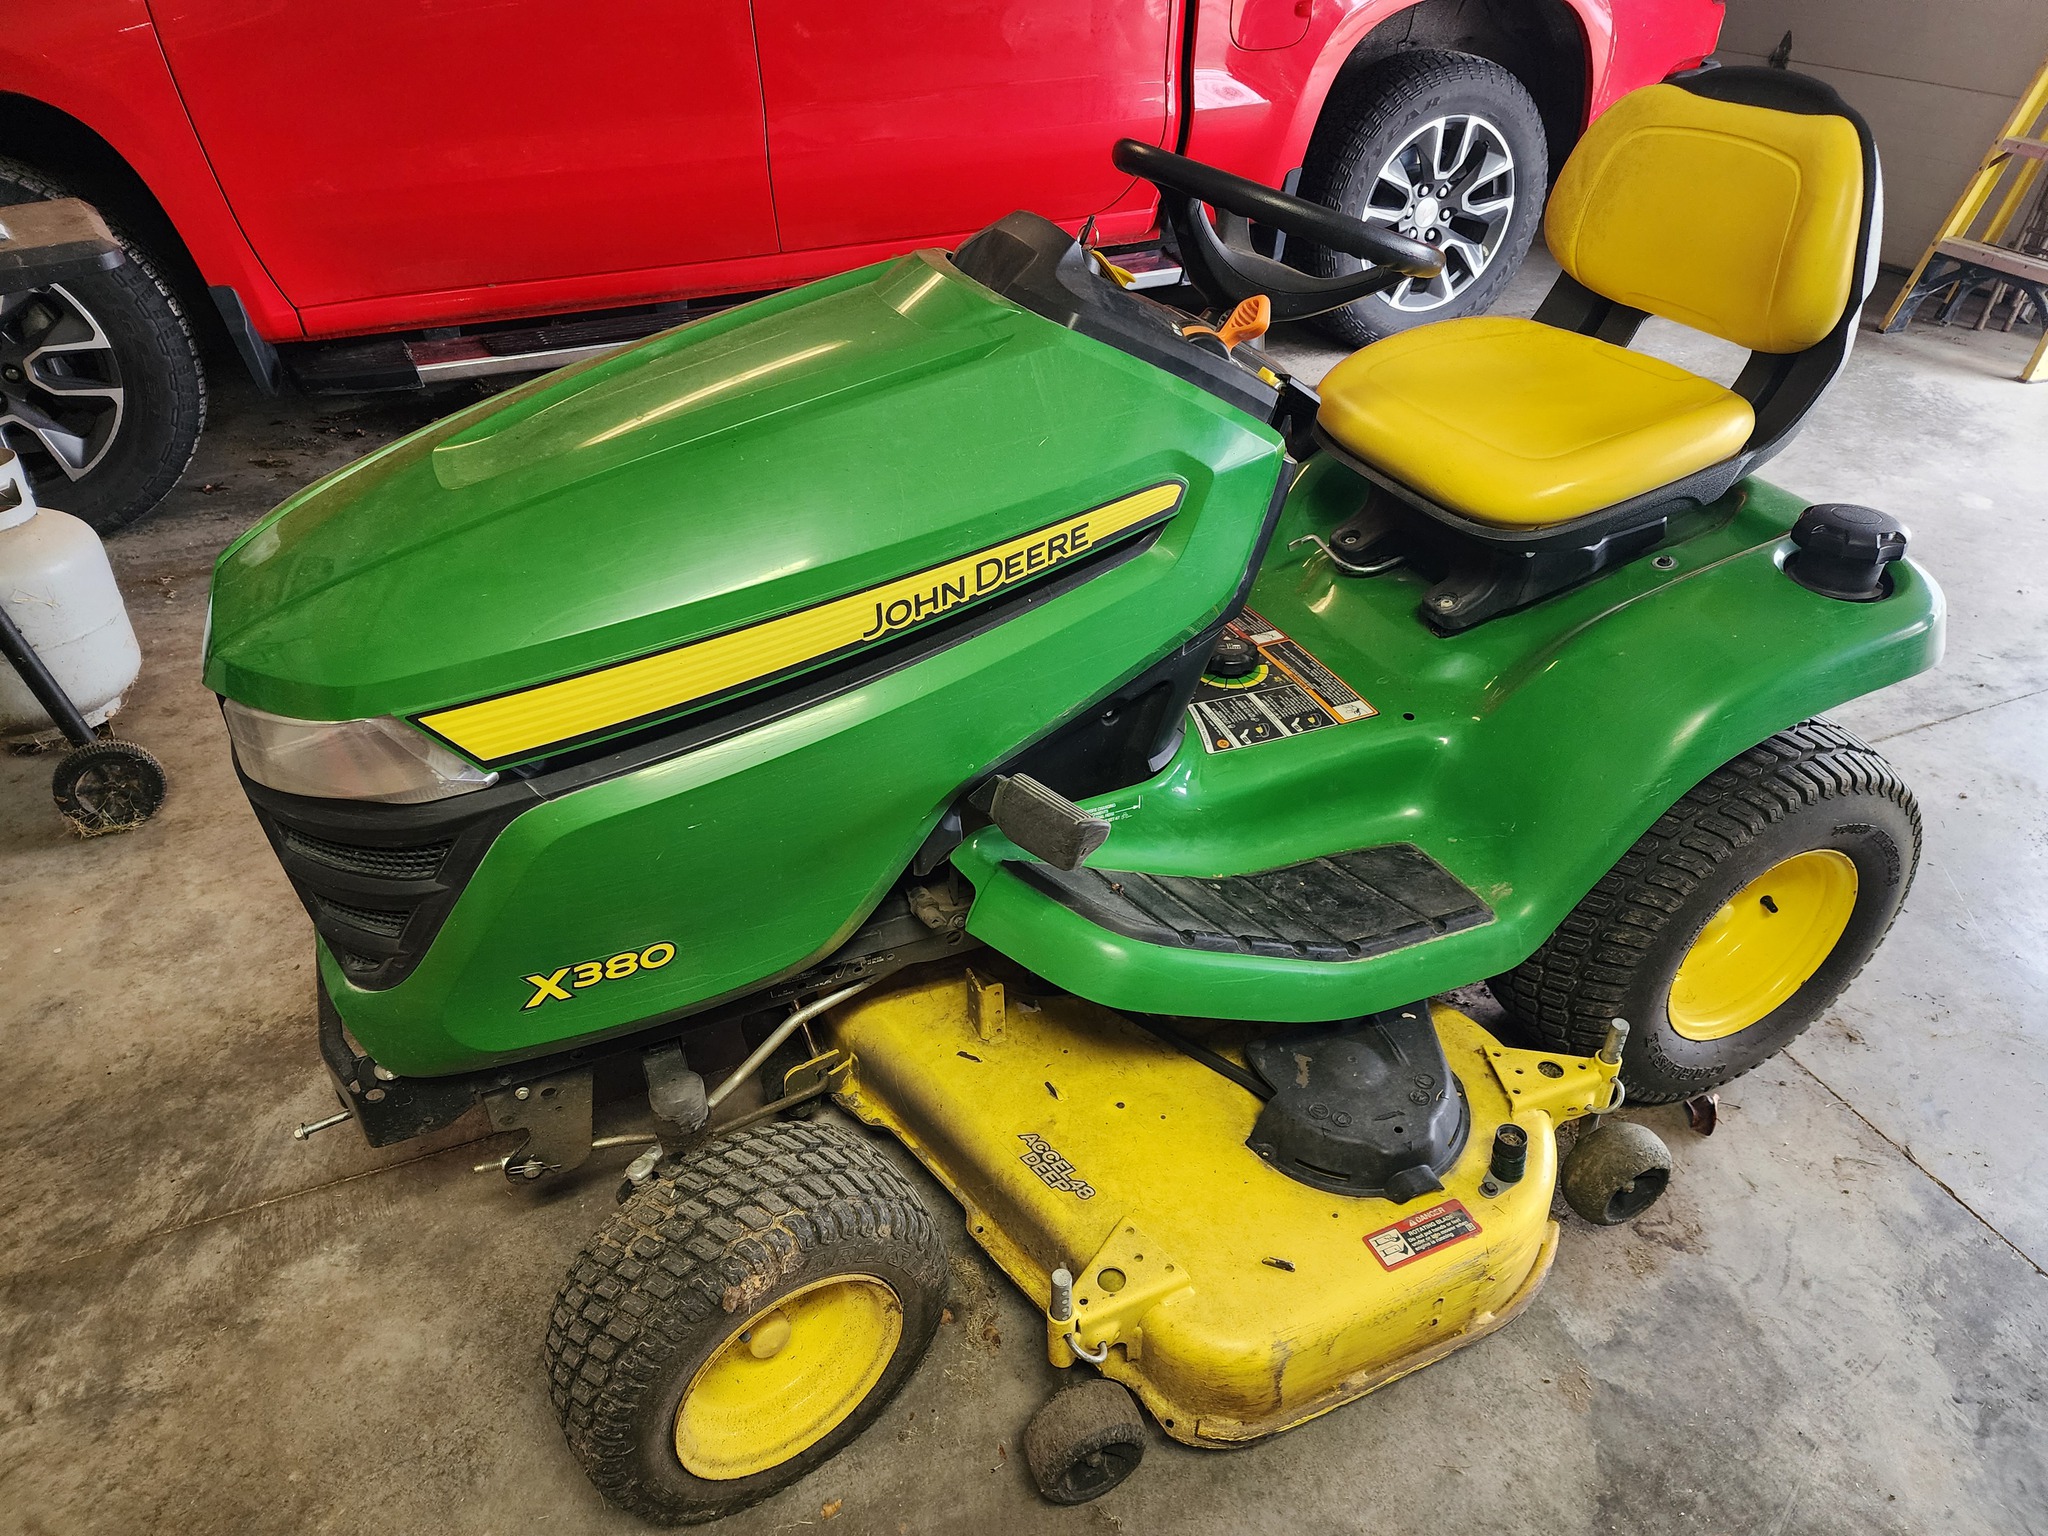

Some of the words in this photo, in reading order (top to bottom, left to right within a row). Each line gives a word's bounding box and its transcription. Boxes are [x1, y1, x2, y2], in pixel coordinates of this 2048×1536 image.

[862, 575, 966, 639] JOHN
[975, 521, 1090, 593] DEERE
[519, 941, 677, 1011] X380
[1645, 1033, 1727, 1081] CARLISLE
[1017, 1132, 1076, 1182] ACCEL
[1069, 1179, 1096, 1200] 48
[1019, 1151, 1071, 1192] DEEP
[1407, 1221, 1436, 1236] ROTATING
[1415, 1207, 1446, 1222] DANGER
[1431, 1224, 1446, 1233] hands
[1411, 1238, 1425, 1247] under
[1440, 1226, 1456, 1235] mower
[1414, 1242, 1431, 1251] engine
[1435, 1232, 1455, 1243] running
